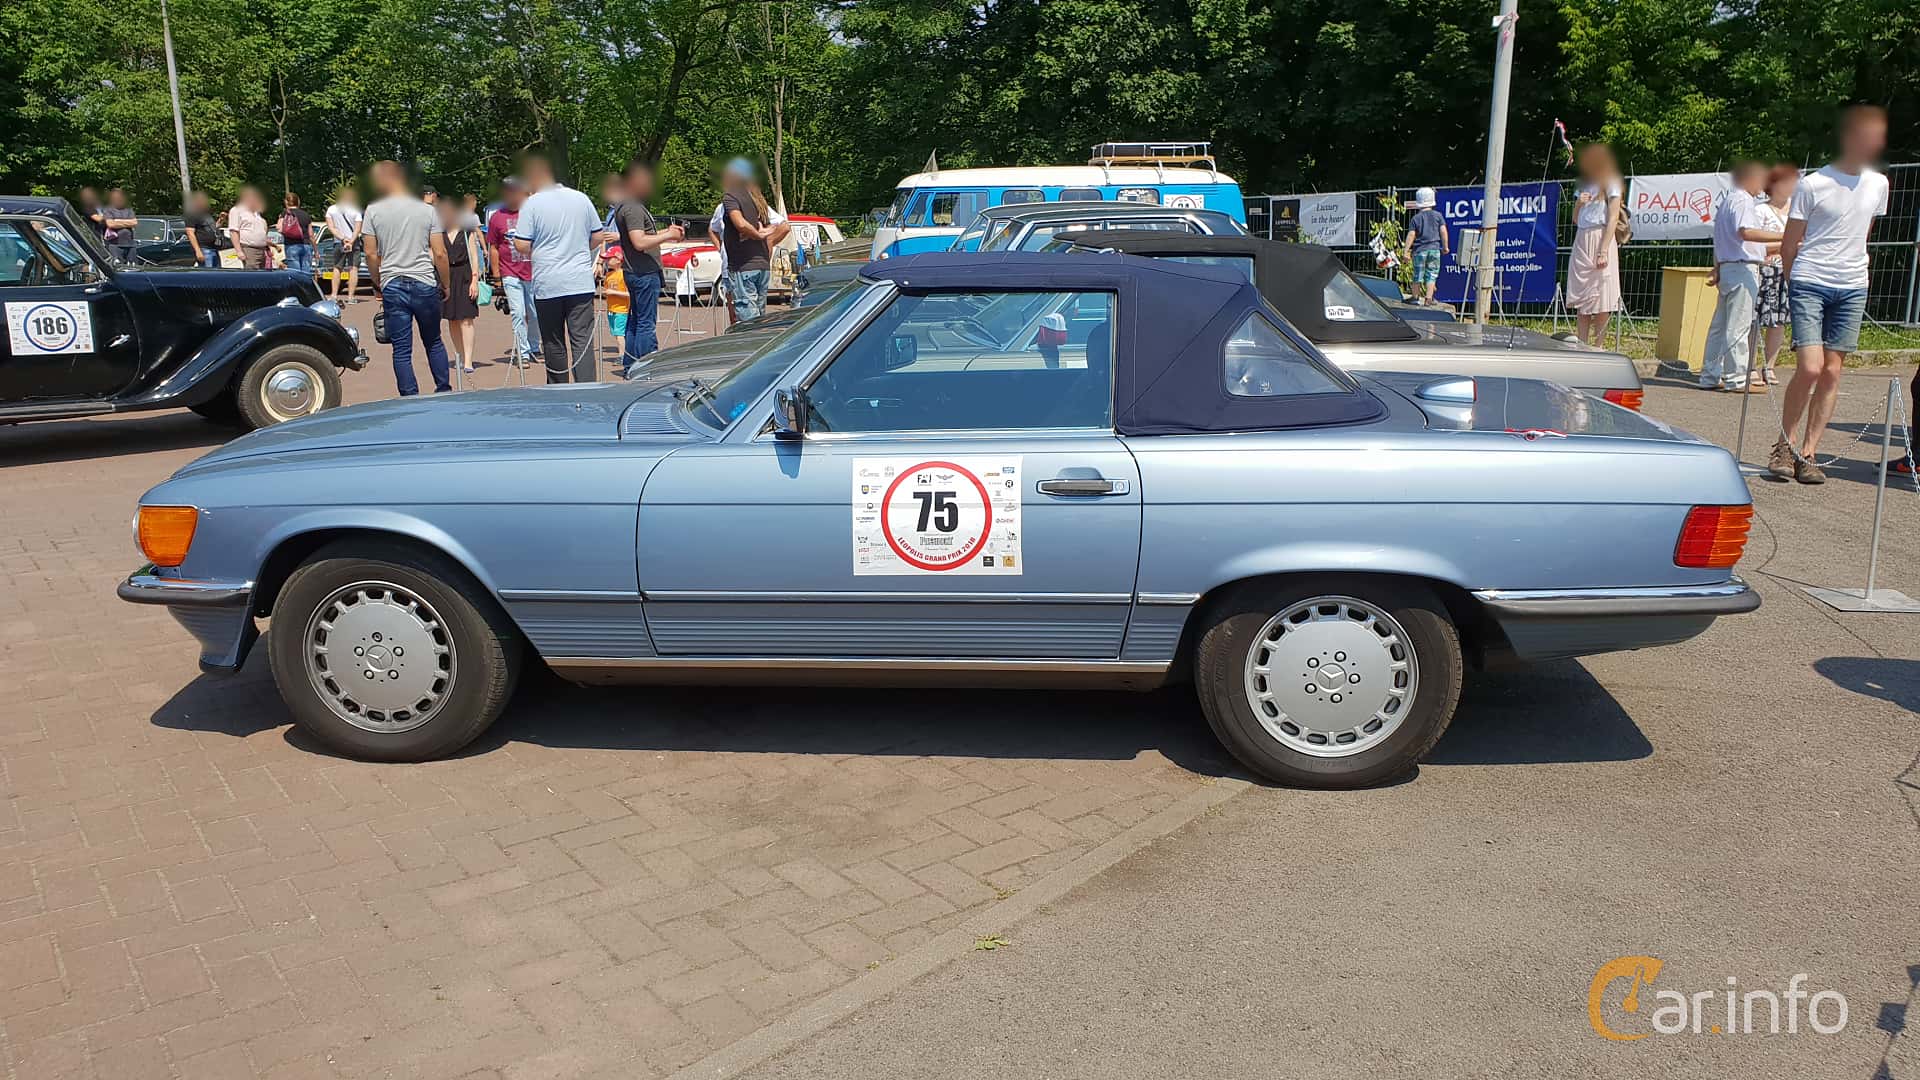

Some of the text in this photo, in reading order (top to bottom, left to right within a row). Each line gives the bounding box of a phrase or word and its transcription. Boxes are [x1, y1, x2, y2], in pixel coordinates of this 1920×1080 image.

[1445, 200, 1469, 218] LC
[1318, 215, 1328, 223] the
[1635, 212, 1689, 225] 100,8 fm
[32, 317, 68, 335] 186
[913, 491, 958, 532] 75
[897, 536, 923, 559] LEOPOLIS
[924, 553, 947, 562] GRAND
[947, 549, 963, 560] PRIX
[962, 536, 977, 552] 2018
